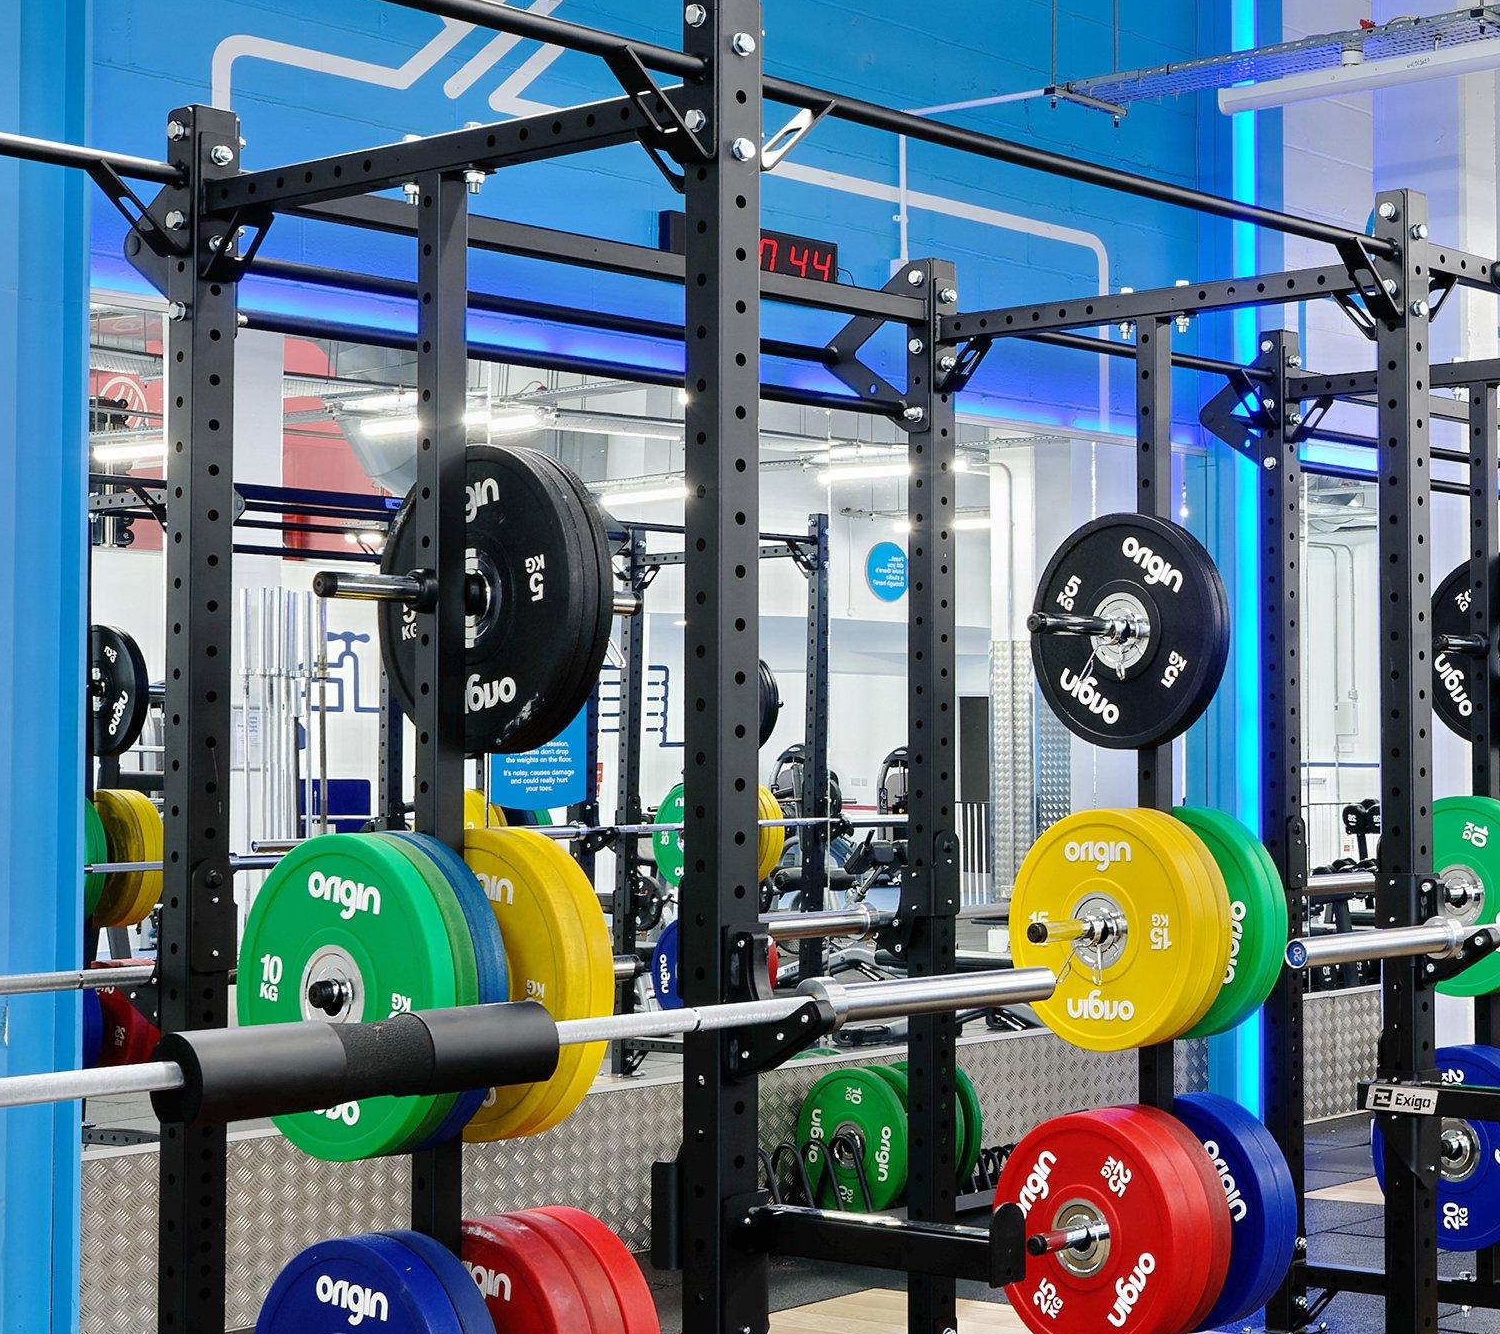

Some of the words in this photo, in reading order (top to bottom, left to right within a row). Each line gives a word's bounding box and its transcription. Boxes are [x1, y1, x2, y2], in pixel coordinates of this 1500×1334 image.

[525, 554, 545, 573] KG
[1122, 536, 1184, 593] origin
[529, 573, 545, 601] 5
[1064, 575, 1082, 597] 5
[1056, 591, 1074, 611] KG
[1168, 651, 1187, 671] KG
[1160, 668, 1180, 689] 5
[1434, 653, 1472, 717] origin
[1059, 667, 1120, 725] origin
[1472, 824, 1490, 848] 10
[1065, 841, 1132, 872] origin
[307, 871, 381, 921] origin
[1152, 914, 1169, 927] KG
[1150, 927, 1172, 951] 15
[1294, 945, 1302, 962] 20
[259, 954, 283, 982] 10
[259, 982, 278, 1003] KG
[1067, 989, 1135, 1021] origin
[1394, 1093, 1431, 1111] Exigo
[878, 1126, 892, 1183] origin
[1100, 1155, 1118, 1179] KG
[1108, 1160, 1132, 1197] 25
[1444, 1202, 1460, 1230] 20
[316, 1274, 389, 1327] origin
[1032, 1277, 1058, 1314] 25
[1107, 1252, 1156, 1328] origin
[1047, 1296, 1064, 1319] KG
